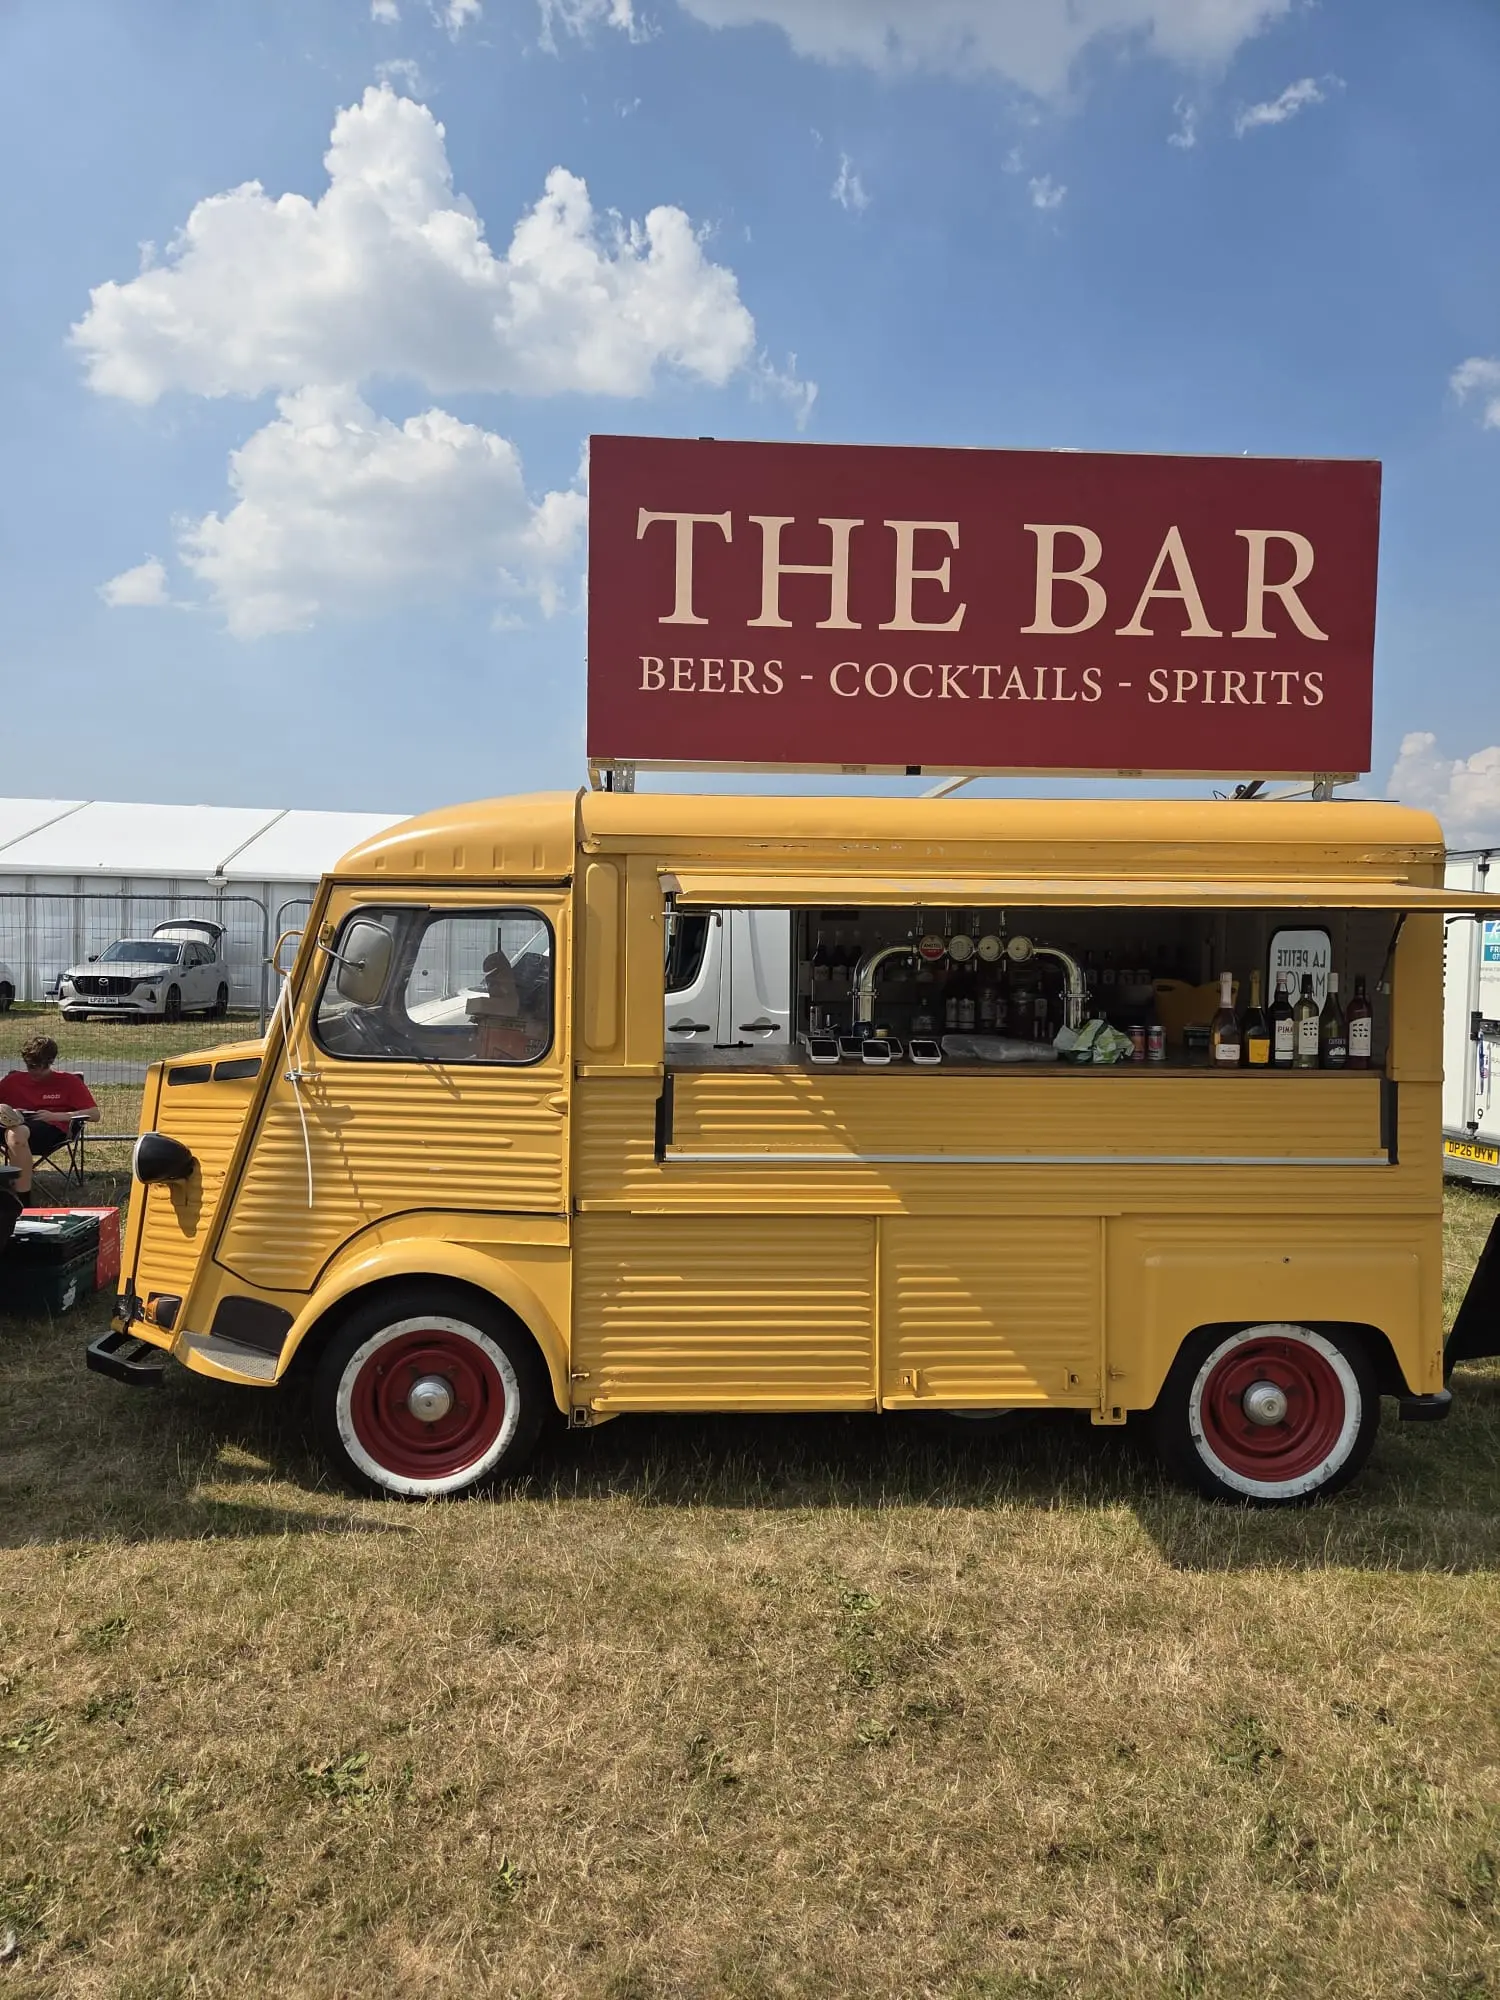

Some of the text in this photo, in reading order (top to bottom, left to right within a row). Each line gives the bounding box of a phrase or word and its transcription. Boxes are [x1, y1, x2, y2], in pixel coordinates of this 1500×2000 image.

[636, 507, 1329, 641] THE BAR
[638, 656, 784, 694] BEERS
[829, 661, 1102, 702] COCKTAILS
[1147, 668, 1324, 706] SPIRITS
[1448, 1140, 1494, 1161] DP26 UYW
